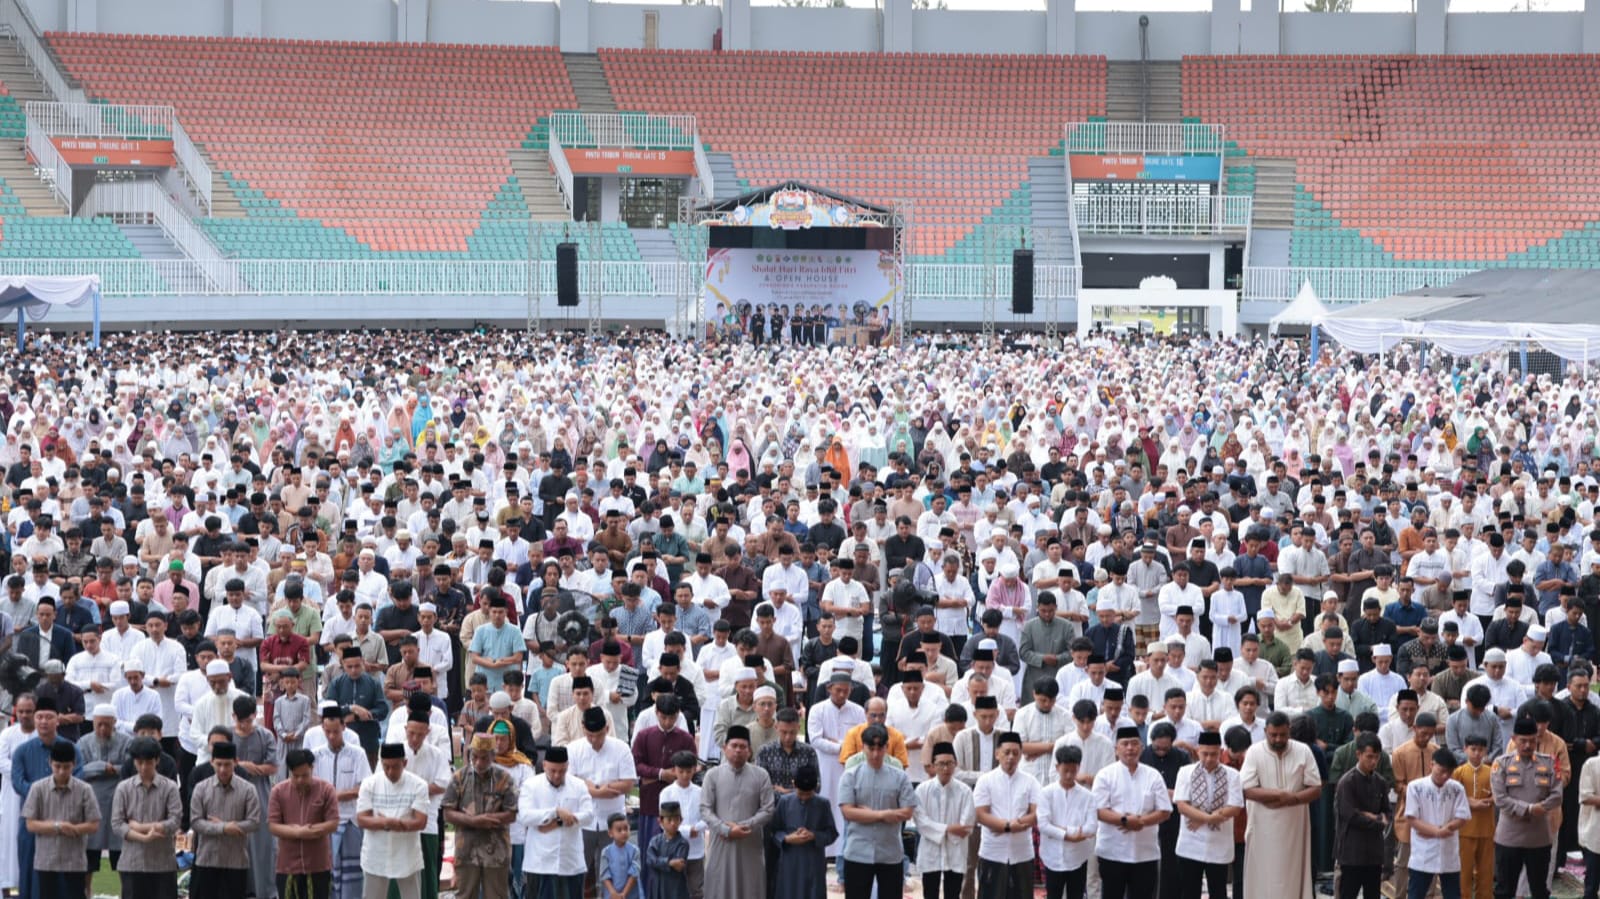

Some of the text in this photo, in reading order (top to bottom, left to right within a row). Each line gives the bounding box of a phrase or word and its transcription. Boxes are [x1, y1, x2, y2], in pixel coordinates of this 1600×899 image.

[61, 140, 77, 149] PINTU
[78, 141, 97, 150] TRIBUN
[120, 142, 133, 151] GATE
[585, 151, 600, 160] PINTU
[601, 151, 620, 160] TRIBUN
[643, 152, 656, 160] GATE
[658, 151, 666, 160] 15
[1118, 157, 1137, 165] TRIBUN
[1161, 157, 1174, 166] GATE
[751, 264, 776, 273] Shalat
[779, 264, 797, 273] Hari
[799, 264, 819, 275] Raya
[839, 264, 857, 273] Fitri
[775, 274, 802, 282] OPEN
[806, 274, 839, 282] HOUSE
